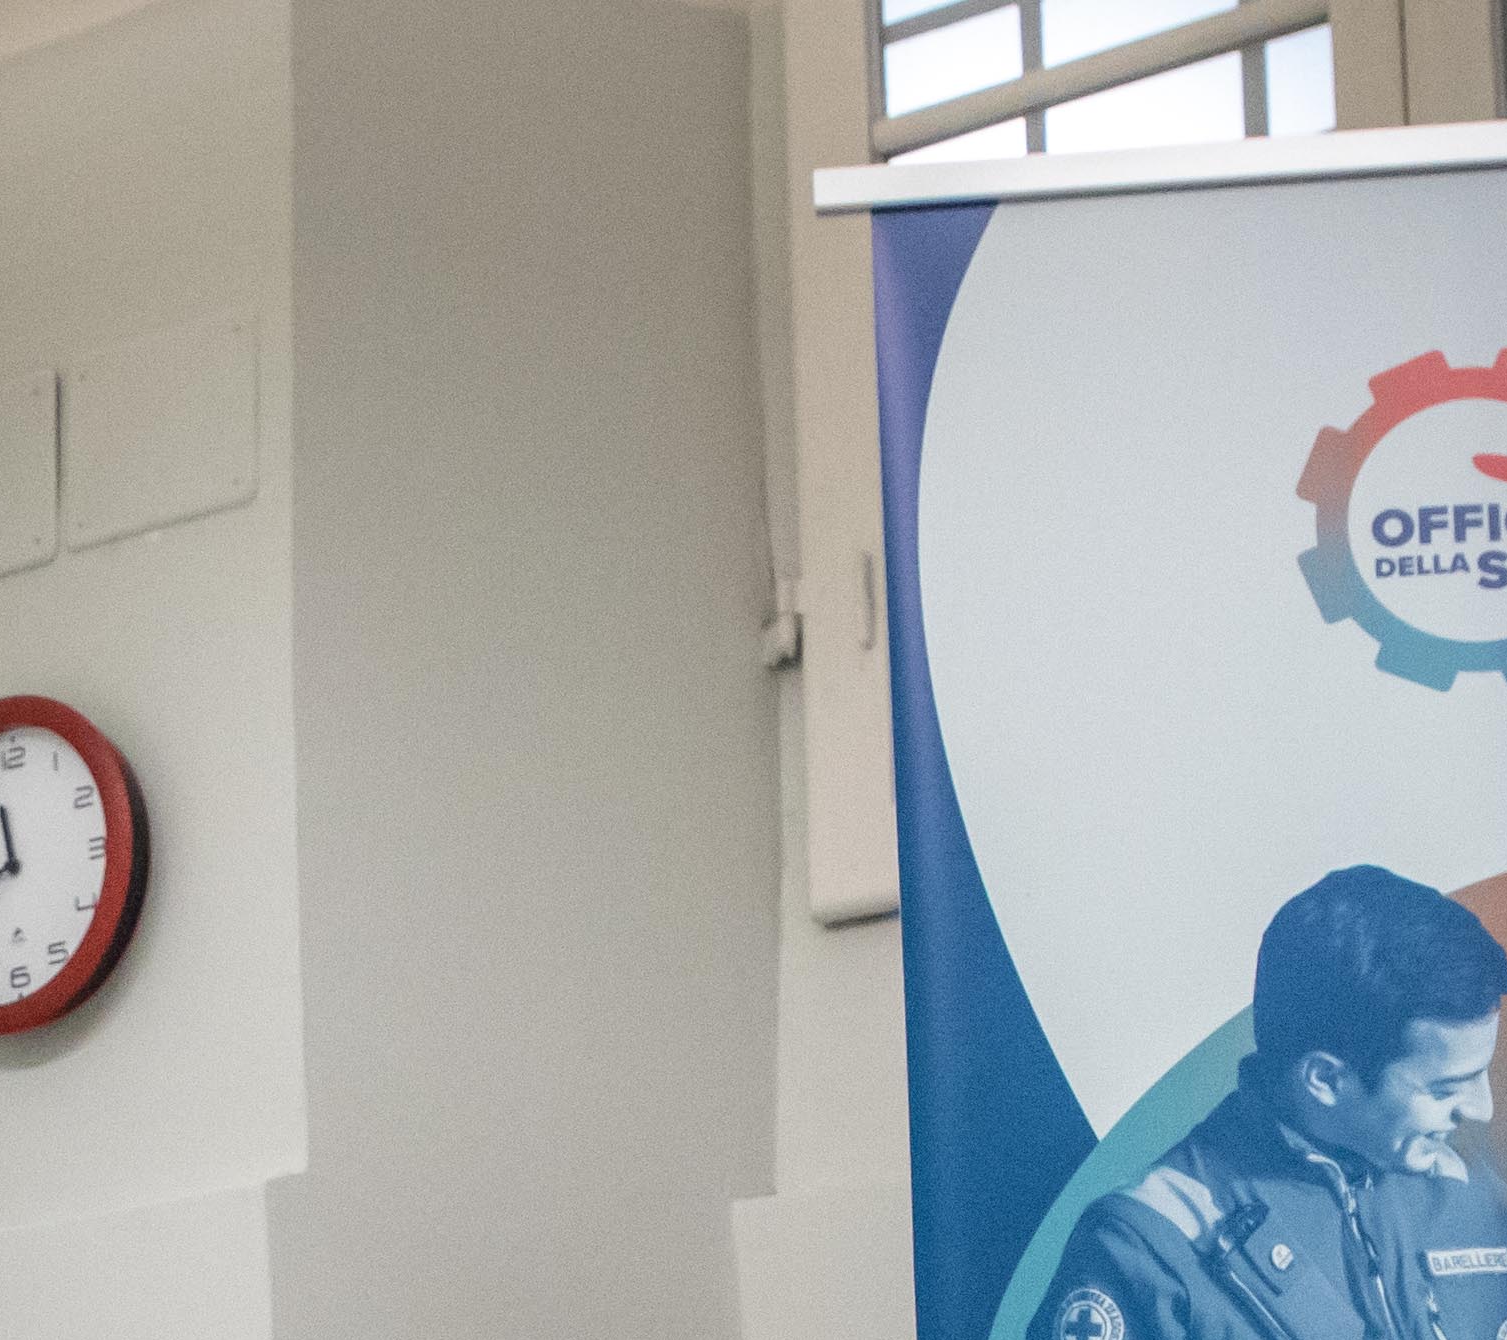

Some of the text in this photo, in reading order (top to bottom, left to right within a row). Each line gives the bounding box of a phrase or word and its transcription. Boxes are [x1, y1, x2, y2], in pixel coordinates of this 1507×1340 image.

[1375, 554, 1471, 579] DELLA
[1, 746, 26, 770] 12
[74, 785, 95, 809] 2
[89, 836, 105, 860] 3
[47, 941, 69, 965] 5
[10, 966, 31, 988] 6
